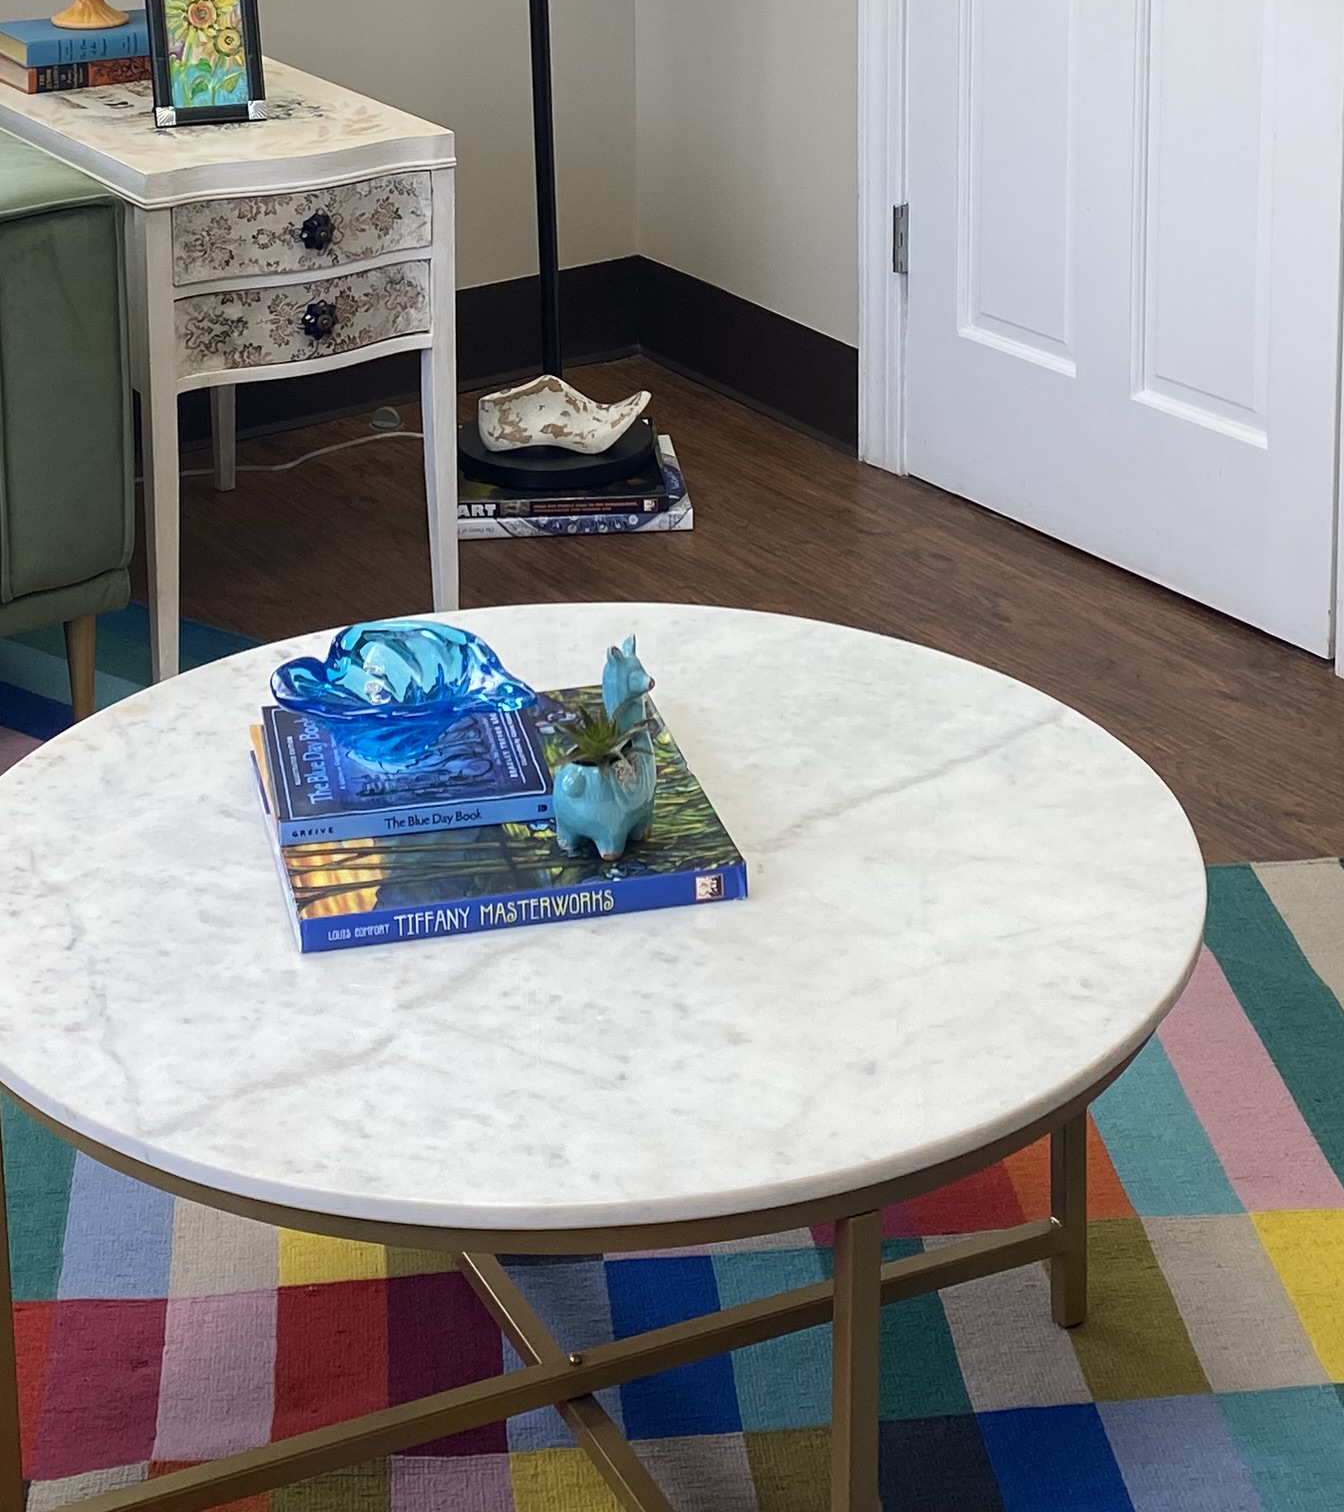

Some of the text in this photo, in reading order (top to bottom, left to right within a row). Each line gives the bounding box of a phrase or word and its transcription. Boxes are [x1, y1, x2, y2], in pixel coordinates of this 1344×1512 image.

[457, 503, 496, 517] ART
[300, 740, 327, 761] Day
[303, 760, 329, 784] Blue
[308, 782, 334, 805] The
[384, 808, 483, 829] The Blue Day Book
[291, 826, 334, 837] GREIVE
[327, 889, 614, 941] LOUIS COMFORT TIFFANY MASTERWORKS
